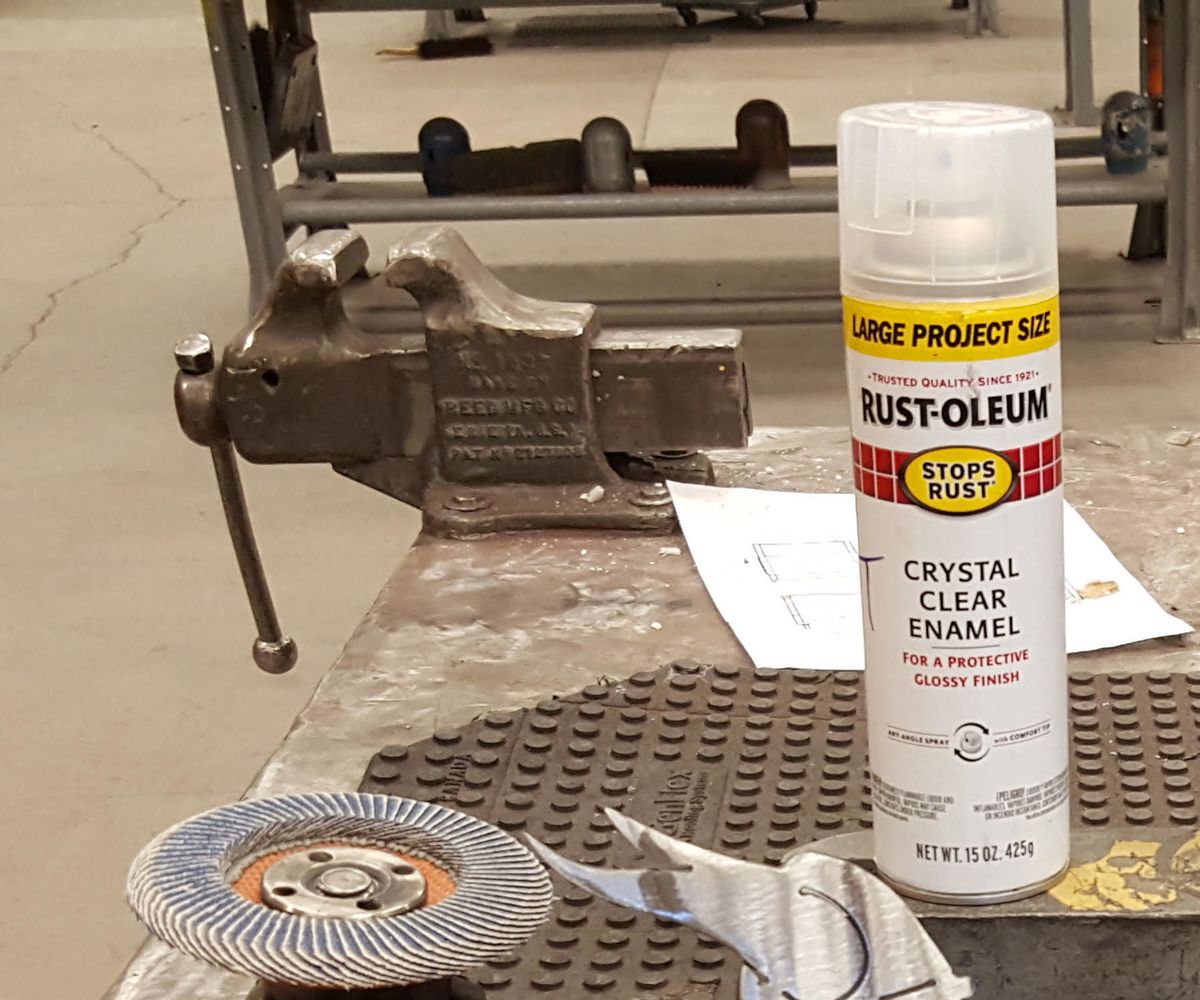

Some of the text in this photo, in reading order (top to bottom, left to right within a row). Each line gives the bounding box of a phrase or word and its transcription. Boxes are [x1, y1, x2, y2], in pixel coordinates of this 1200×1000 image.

[852, 311, 1051, 348] LARGE PROJECT SIZE
[872, 370, 1036, 389] TRUSTED QUALITY SINCE 1921
[861, 386, 1050, 428] RUST-OLEUM
[922, 460, 996, 481] STOPS
[929, 481, 990, 500] RUST
[904, 558, 1019, 583] CRYSTAL
[919, 589, 1007, 612] CLEAR
[909, 616, 1020, 640] ENAMEL
[902, 649, 1029, 668] FOR A PROTECTIVE
[914, 671, 1020, 687] GLOSSY FINISH
[1009, 728, 1041, 742] COMFORT
[915, 840, 1034, 863] NET WT. 15 OZ. 425g
